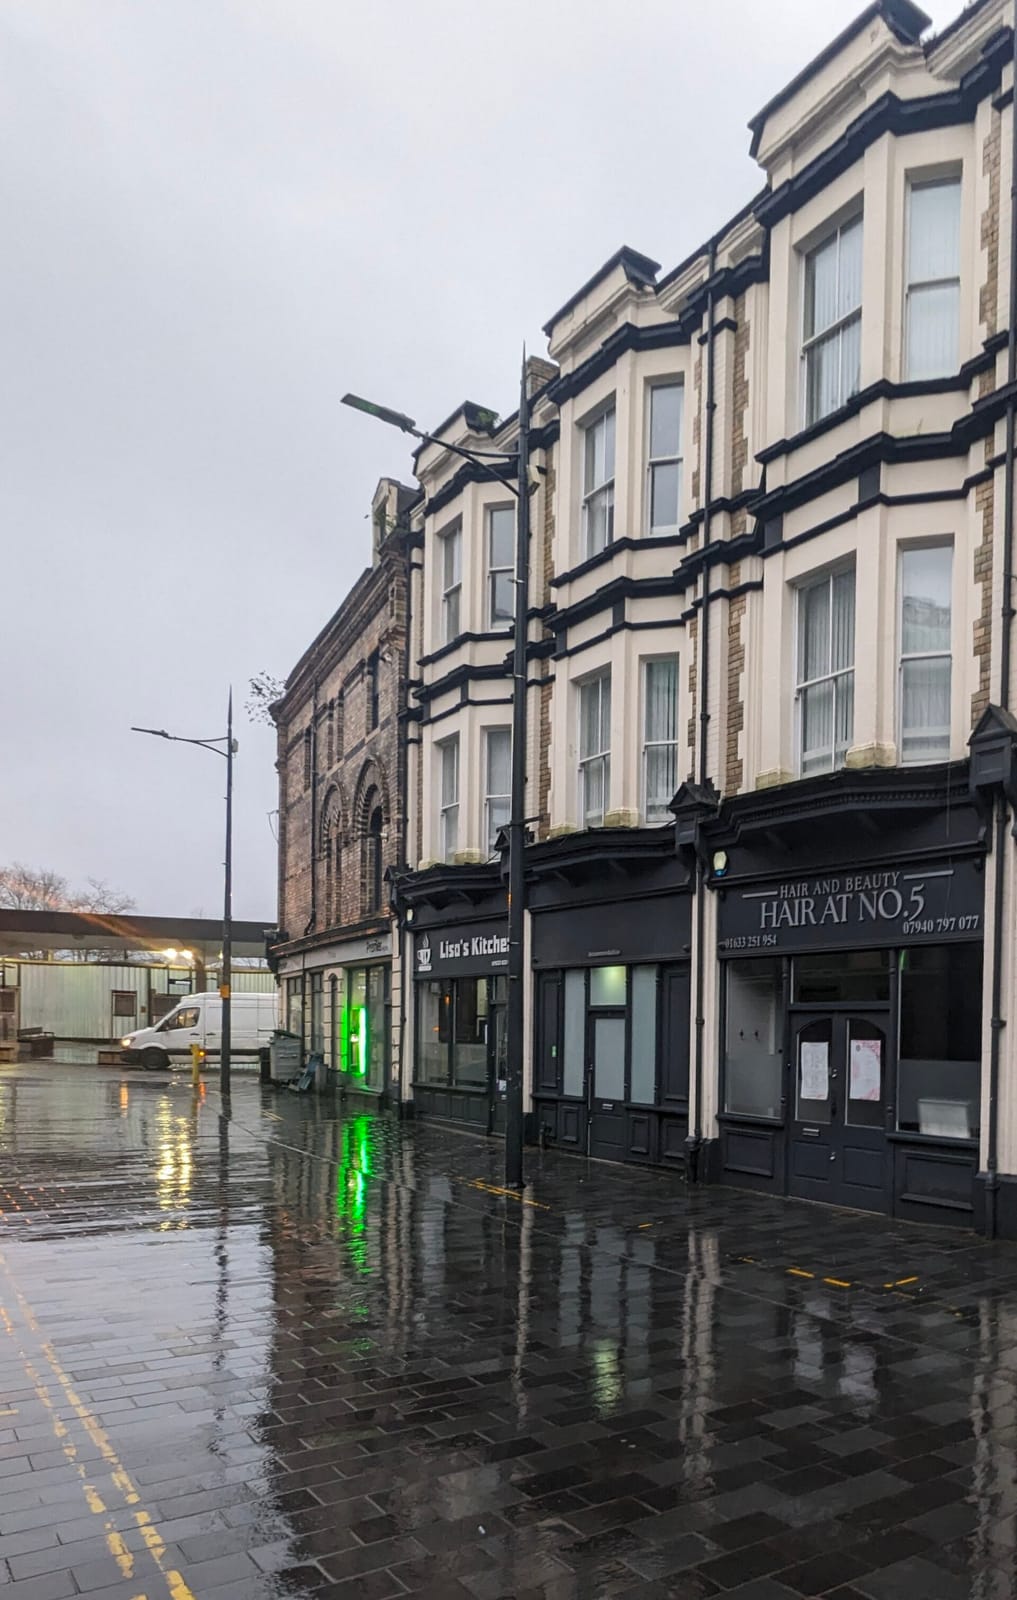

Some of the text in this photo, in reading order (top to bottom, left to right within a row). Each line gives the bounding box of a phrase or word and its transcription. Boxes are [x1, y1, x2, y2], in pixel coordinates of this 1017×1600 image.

[780, 872, 901, 899] HAIR AND BEAUTY
[760, 898, 817, 928] HAIR
[820, 893, 854, 925] AT
[903, 915, 979, 934] 07940 797 077
[440, 939, 469, 959] Lisa's
[747, 936, 760, 947] 251
[762, 934, 776, 946] 954
